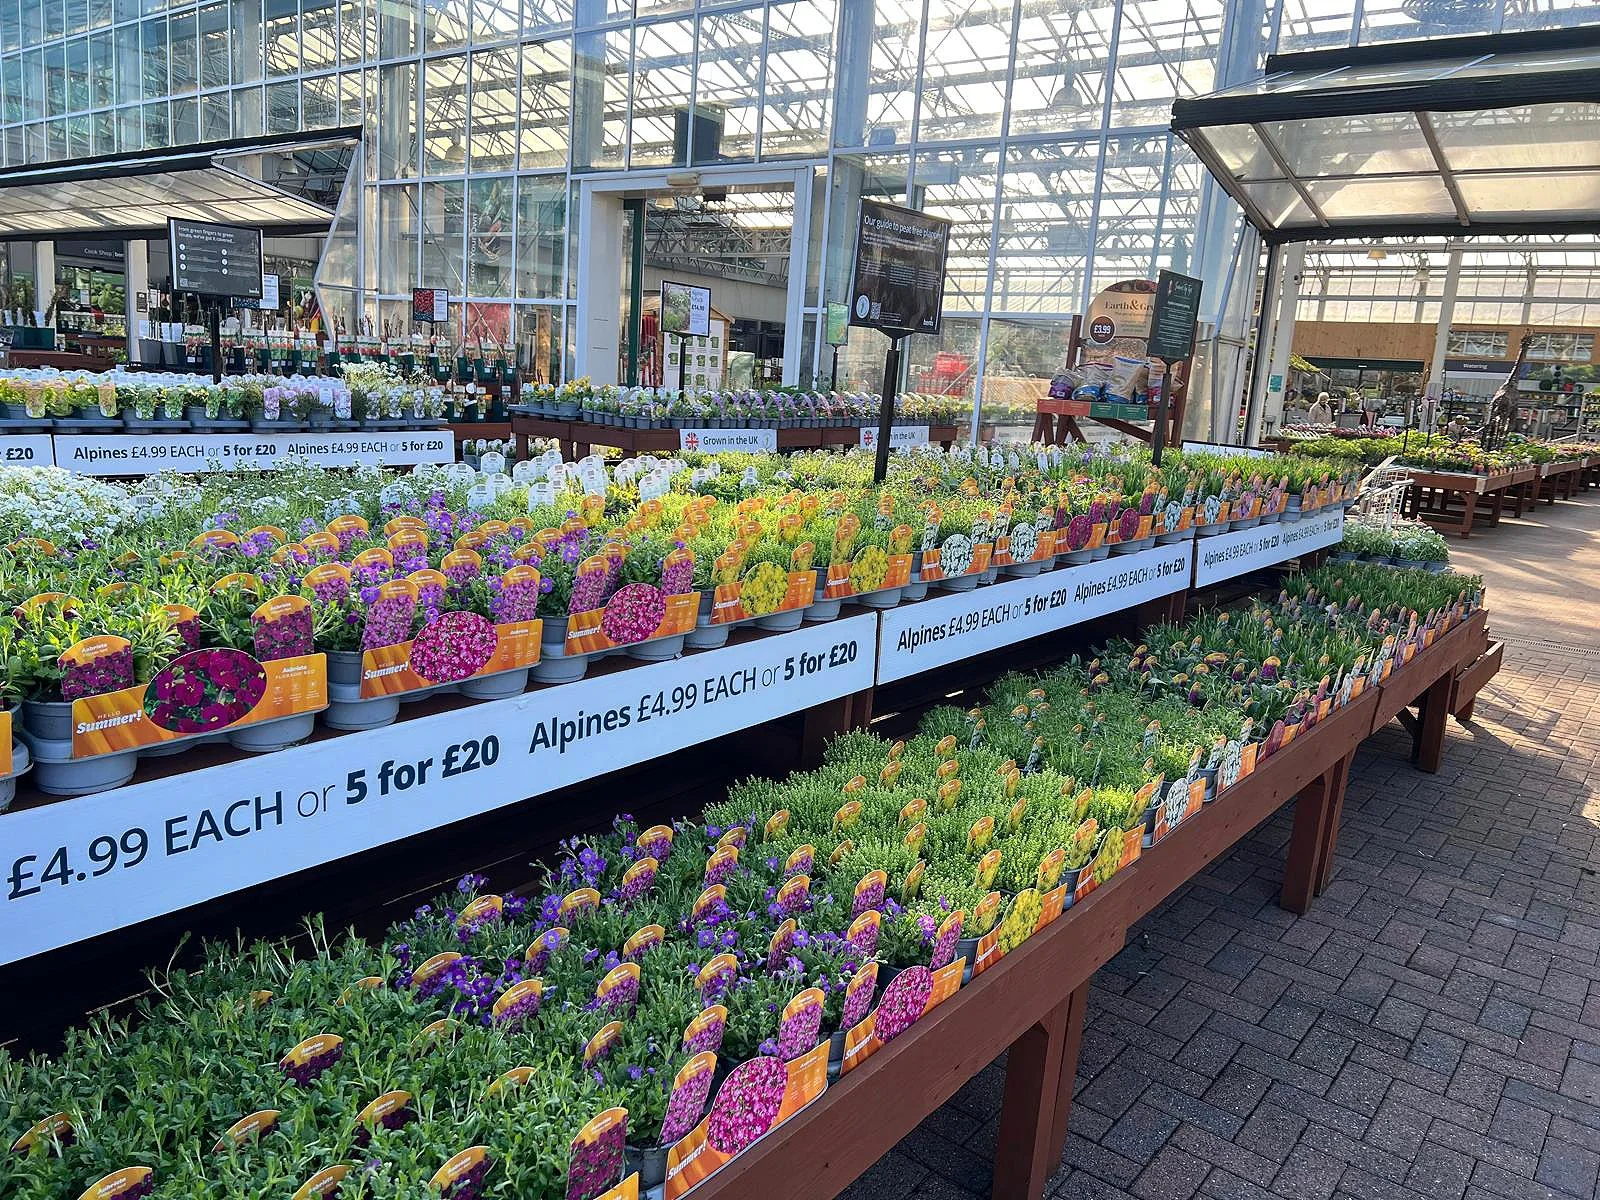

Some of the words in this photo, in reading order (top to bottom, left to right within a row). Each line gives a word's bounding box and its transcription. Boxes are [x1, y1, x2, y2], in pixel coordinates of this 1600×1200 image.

[864, 216, 876, 226] Our
[876, 218, 892, 230] guide
[892, 222, 899, 231] to
[1094, 324, 1111, 334] £3.99
[703, 436, 727, 445] Grown
[728, 436, 733, 445] in
[736, 436, 748, 444] the
[748, 436, 758, 444] UK
[6, 448, 34, 460] £20
[74, 446, 128, 462] Alpines
[131, 446, 167, 458] £4.99
[170, 445, 204, 458] EACH
[208, 447, 220, 457] or
[223, 445, 231, 456] 5
[233, 444, 253, 456] for
[255, 444, 276, 456] £20
[288, 442, 329, 456] Alpines
[331, 442, 359, 455] £4.99
[360, 441, 388, 453] EACH
[390, 444, 400, 452] or
[402, 441, 408, 452] 5
[410, 440, 425, 451] for
[426, 440, 443, 451] £20
[1204, 550, 1225, 569] Alpines
[1240, 541, 1253, 556] EACH
[1271, 535, 1279, 548] £20
[896, 624, 946, 654] Alpines
[948, 612, 980, 637] £4.99
[981, 603, 1010, 628] EACH
[1012, 603, 1024, 619] or
[1024, 597, 1031, 616] 5
[1033, 594, 1048, 614] for
[1050, 588, 1067, 608] £20
[1074, 580, 1106, 605] Alpines
[1107, 572, 1128, 592] £4.99
[1128, 567, 1148, 586] EACH
[1149, 568, 1156, 581] or
[1157, 563, 1162, 579] 5
[1162, 561, 1173, 576] for
[1173, 557, 1185, 574] £20
[568, 625, 600, 640] Summer!
[364, 661, 409, 680] Summer!
[76, 709, 142, 734] Summer!
[98, 710, 120, 719] HELLO
[6, 828, 148, 901] £4.99
[165, 790, 282, 856] EACH
[297, 784, 336, 817] or
[346, 769, 368, 805] 5
[377, 757, 433, 796] for
[442, 734, 499, 778] £20
[528, 706, 631, 754] Alpines
[637, 683, 697, 723] £4.99
[704, 666, 756, 704] EACH
[761, 665, 781, 687] or
[784, 656, 794, 680] 5
[799, 652, 826, 676] for
[828, 640, 857, 668] £20
[668, 1139, 707, 1180] Summer!
